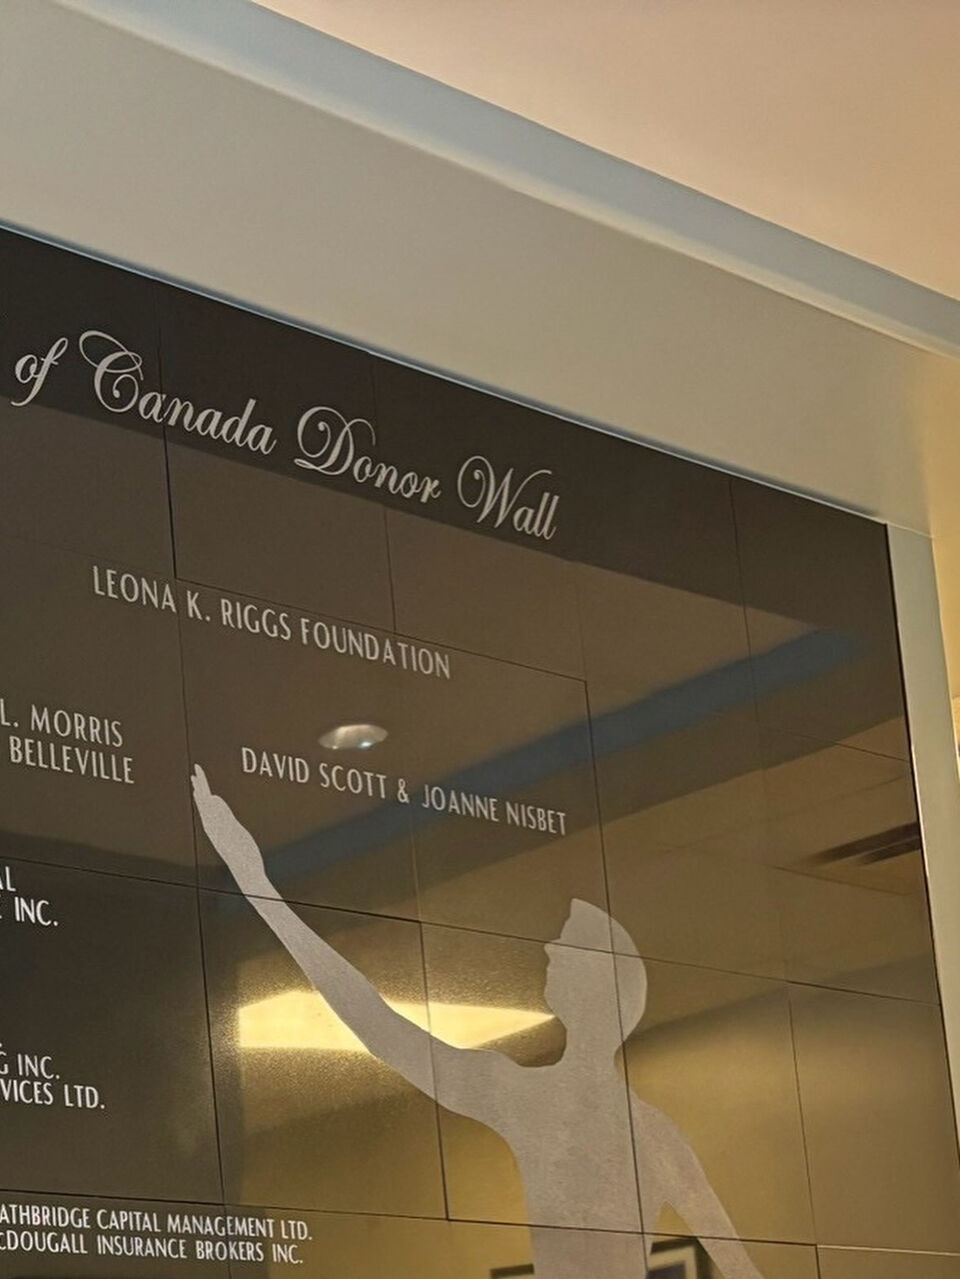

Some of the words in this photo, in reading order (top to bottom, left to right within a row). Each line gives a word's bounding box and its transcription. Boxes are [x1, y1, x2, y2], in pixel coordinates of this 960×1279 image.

[10, 337, 68, 406] of
[79, 330, 276, 455] Canada
[294, 406, 441, 503] Donor
[457, 455, 559, 541] Wall
[93, 566, 176, 613] LEONA
[187, 589, 210, 621] K.
[221, 598, 291, 641] RIGGS
[301, 617, 451, 679] FOUNDATION
[0, 697, 19, 728] L.
[31, 703, 123, 747] MORRIS
[10, 735, 134, 784] BELLEVILLE
[242, 747, 308, 786] DAVID
[319, 763, 386, 800] SCOTT
[398, 779, 409, 805] &
[422, 783, 499, 822] JOANNE
[506, 800, 566, 835] NISBET
[14, 895, 59, 927] INC.
[17, 1051, 60, 1079] INC.
[64, 1082, 105, 1109] LTD.
[97, 1209, 161, 1232] CAPITAL
[167, 1213, 274, 1238] MANAGEMENT
[281, 1219, 312, 1240] LTD.
[97, 1235, 186, 1259] INSURANCE
[196, 1240, 264, 1262] BROKERS
[272, 1244, 303, 1264] INC.
